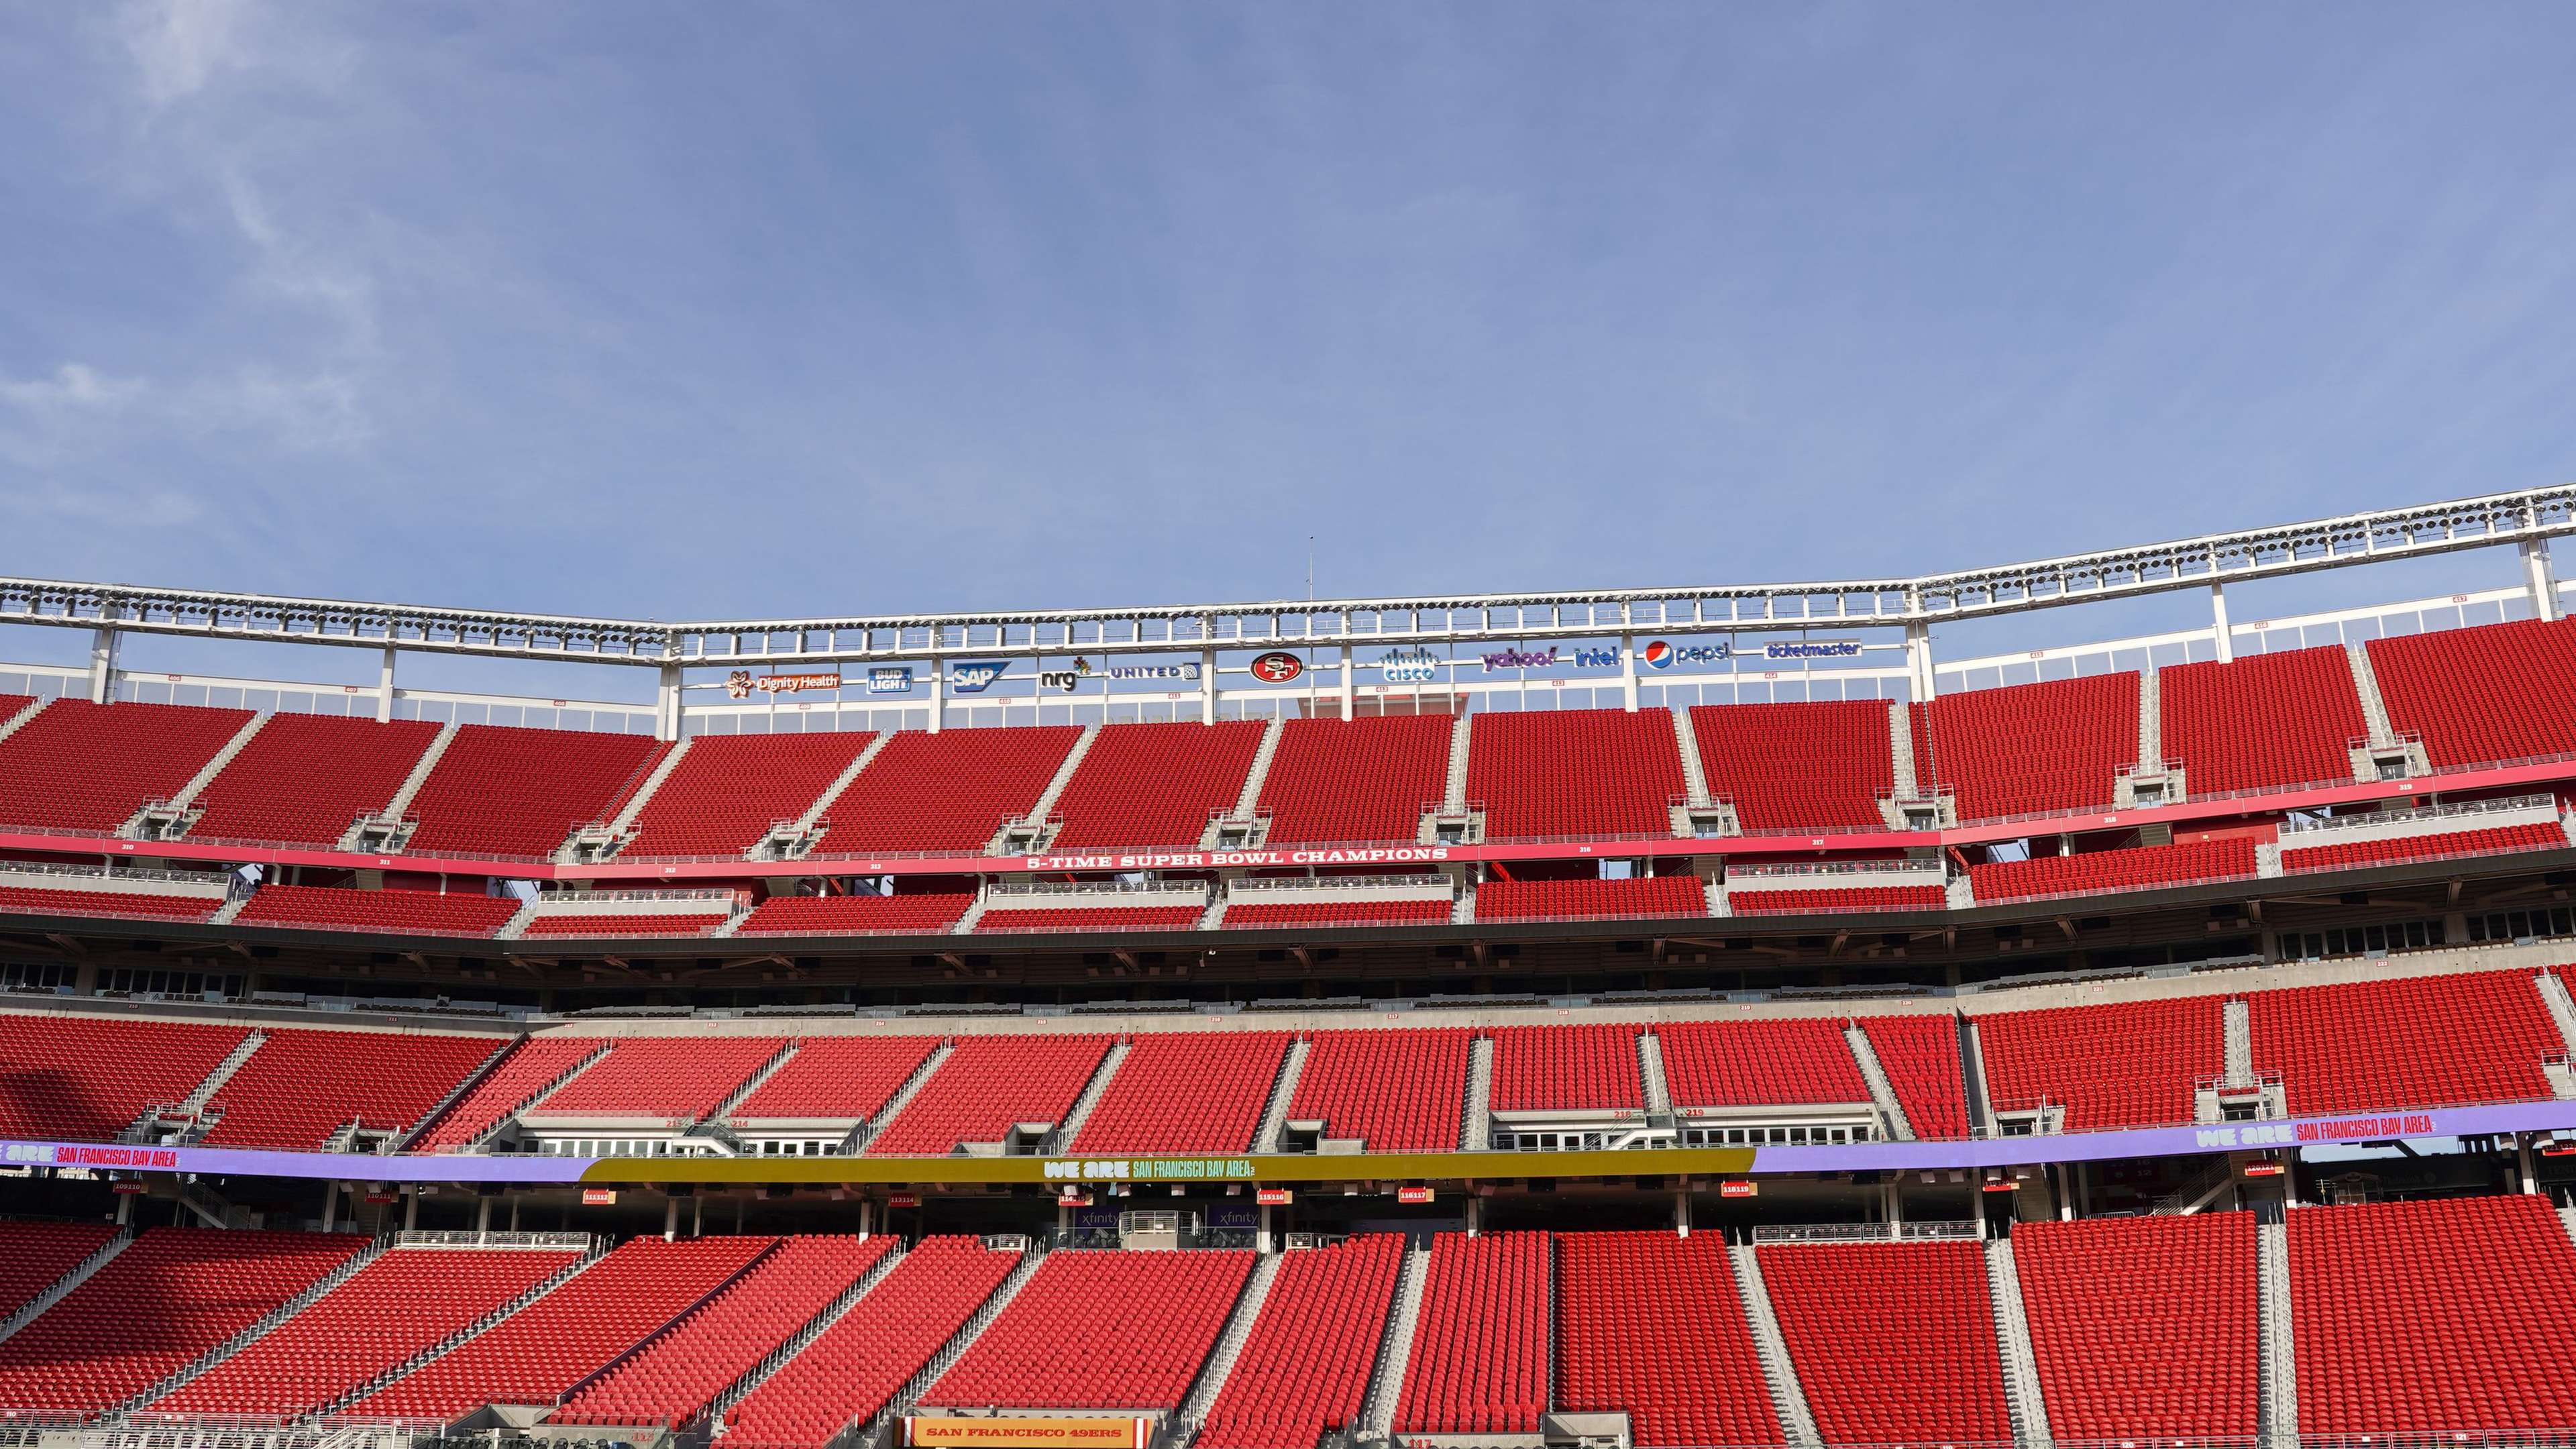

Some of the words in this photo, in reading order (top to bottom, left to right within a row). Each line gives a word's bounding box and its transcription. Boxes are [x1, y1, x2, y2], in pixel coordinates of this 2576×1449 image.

[1483, 646, 1558, 672] yahoo!
[1574, 646, 1618, 667] intel
[1675, 642, 1729, 663] pepsi
[1767, 643, 1861, 657] ticketmaster
[875, 669, 902, 680] BUD
[955, 668, 994, 686] SAP
[1041, 670, 1077, 692] nrg
[1111, 666, 1181, 678] UNITED
[759, 676, 799, 694] Dignity
[800, 675, 838, 688] Health
[871, 679, 906, 690] LIGHT
[1027, 856, 1112, 869] 5-TIME
[1120, 853, 1203, 867] SUPER
[1211, 852, 1283, 865] BOWL
[1293, 848, 1448, 863] CHAMPIONS
[2196, 1129, 2238, 1148] WE
[2296, 1123, 2319, 1141] SAN
[2322, 1118, 2379, 1140] FRANCISCO
[2380, 1117, 2402, 1136] BAY
[2404, 1115, 2432, 1134] AREA
[57, 1146, 76, 1163] SAN
[78, 1148, 131, 1166] FRANCISCO
[132, 1150, 152, 1166] BAY
[152, 1151, 176, 1167] AREA
[1044, 1161, 1080, 1179] WE
[1133, 1161, 1152, 1178] SAN
[1154, 1160, 1205, 1177] FRANCISCO
[1207, 1160, 1225, 1177] BAY
[1226, 1160, 1250, 1177] AREA
[1082, 1210, 1119, 1226] xfinity
[1220, 1210, 1258, 1226] xfinity
[926, 1428, 964, 1437] SAN
[967, 1428, 1065, 1437] FRANCISCO
[1070, 1428, 1122, 1438] 49ERS
